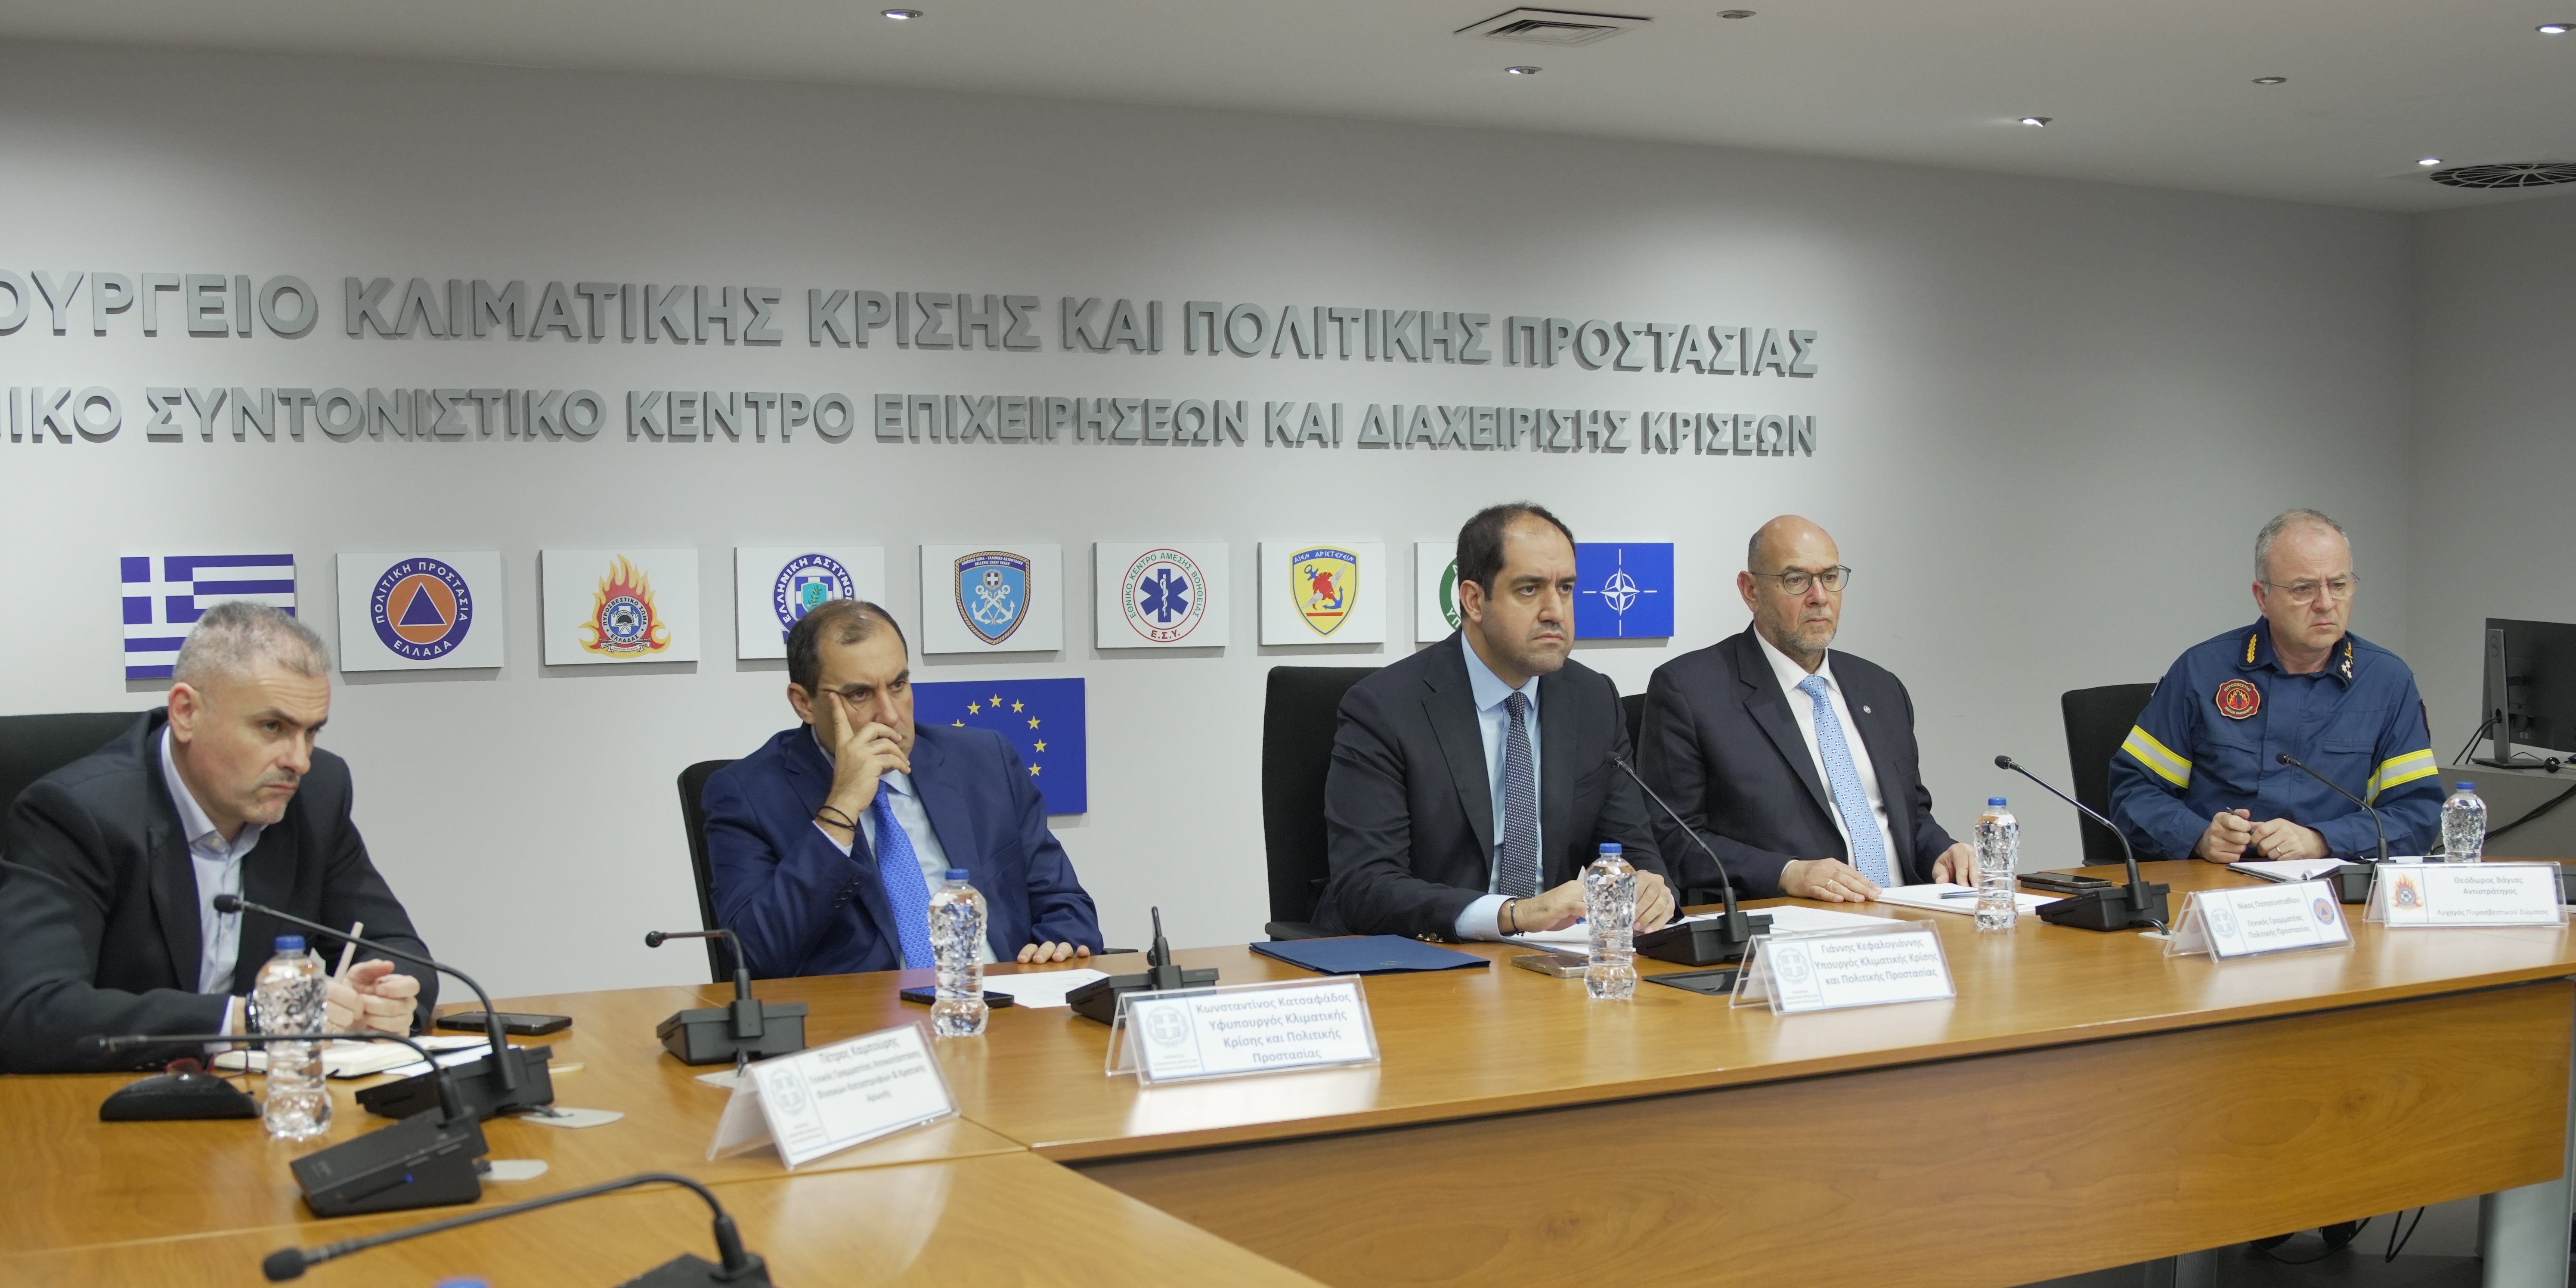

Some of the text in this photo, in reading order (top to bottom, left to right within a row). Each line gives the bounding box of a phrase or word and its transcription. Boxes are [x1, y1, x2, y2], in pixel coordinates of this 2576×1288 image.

[345, 276, 783, 345] ΚΛΙΜΑΤΙΚΗΣ
[808, 289, 1041, 351] ΚΡΙΣΗΣ
[1062, 297, 1163, 355] ΚΑΙ
[1183, 301, 1491, 365] ΠΟΛΙΤΙΚΗΣ
[1506, 316, 1817, 378] ΠΡΟΣΤΑΣΙΑΣ
[0, 386, 1817, 457] ΙΚΟ ΣΥΝΤΟΝΙΣΤΙΚΟ ΚΕΝΤΡΟ ΕΠΙΧΕΙΡΗΣΕΩΝ ΚΑΙ ΔΙΑΧΕΙΡΙΣΗΣ ΚΡΙΣΕΩΝ
[1294, 551, 1354, 563] ΑΙΕΝ ΑΡΙΣΤΕΥΕΙΝ
[375, 562, 468, 624] ΠΟΛΙΤΙΚΗ ΠΡΟΣΤΑΣΙΑ
[777, 556, 853, 624] ΕΛΛΗΝΙΚΗ ΑΣΤΥΝΟ
[1125, 552, 1203, 618] ΕΘΝΙΚΟ ΚΕΝΤΡΟ ΑΜΕΣΗΣ ΒΟΗΘΕΙΑΣ
[603, 597, 647, 626] ΠΥΡΟΣΒΕΣΤΙΚΟ ΣΩΜΑ
[610, 633, 639, 642] ΕΛΛΑΔΑΣ
[1151, 630, 1180, 639] Ε.Σ.Υ.
[393, 640, 452, 656] ΕΛΛΑΔΑ
[2496, 876, 2523, 884] Βάγιας
[2463, 888, 2517, 896] Αντιστράτηγος
[2238, 902, 2255, 910] Νίκος
[2437, 909, 2465, 917] Αρχηγός
[2247, 914, 2304, 928] Γενικός Γραμματέας
[2248, 925, 2311, 939] Πολιτικής Προστασίας
[1821, 937, 1924, 954] Γιάννης Κεφαλογιάννης
[1814, 952, 1938, 971] Υπουργός Κλιματικής Κρίσης
[1825, 968, 1938, 985] και Πολιτικής Προστασίας
[1196, 992, 1352, 1015] Κωνσταντίνος Κατσαφάδος
[1209, 1009, 1347, 1032] Υφυπουργός Κλιματικής
[1223, 1028, 1342, 1049] Κρίσης και Πολιτικής
[1253, 1048, 1322, 1065] Προστασίας
